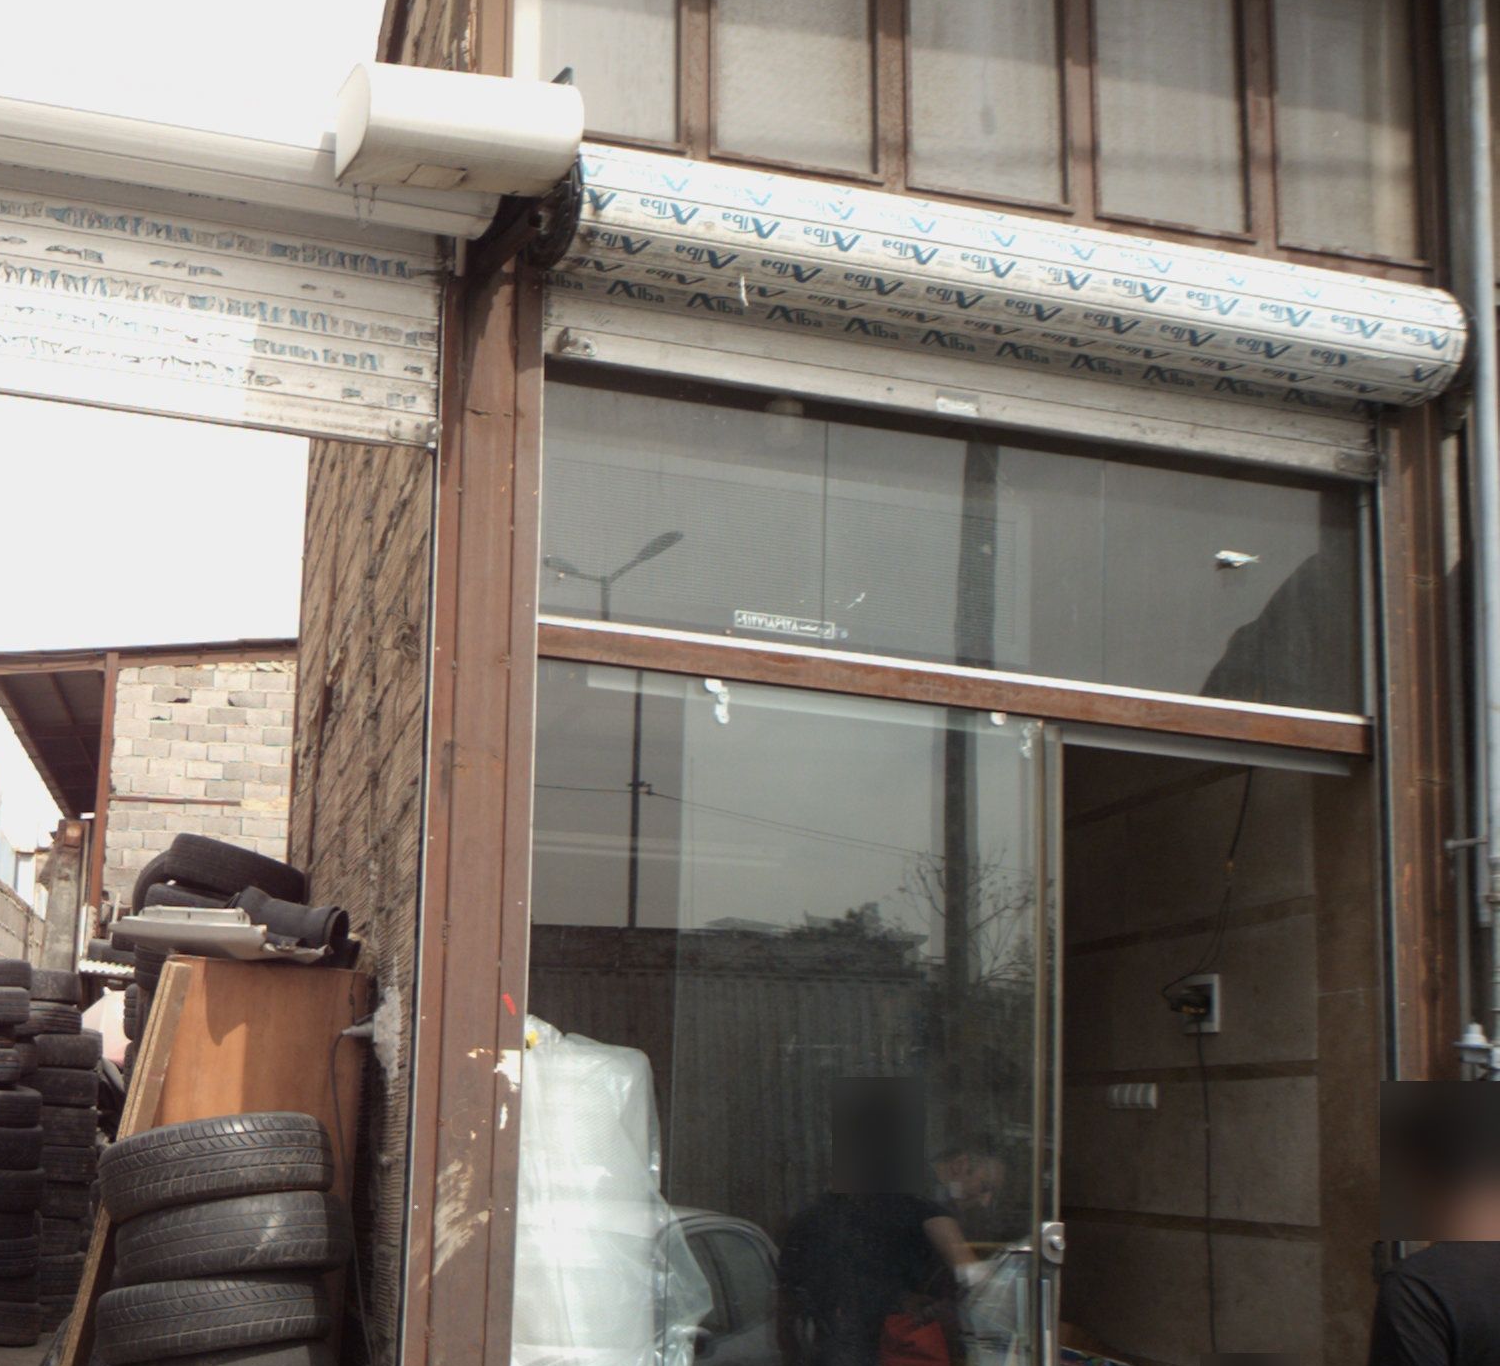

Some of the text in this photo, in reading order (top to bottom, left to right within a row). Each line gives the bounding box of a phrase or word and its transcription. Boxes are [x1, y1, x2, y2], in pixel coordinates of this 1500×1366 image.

[640, 197, 699, 225] Alba
[722, 212, 780, 239] Alba
[803, 226, 860, 252] Alba
[675, 244, 739, 270] Alba
[882, 239, 939, 265] Alba
[761, 258, 823, 284] Alba
[960, 252, 1017, 278] Alba
[844, 272, 904, 296] Alba
[1113, 278, 1167, 303] Alba
[926, 285, 985, 309] Alba
[1186, 290, 1239, 315] Alba
[1005, 298, 1063, 322] Alba
[1259, 302, 1312, 327] Alba
[1083, 311, 1141, 335] Alba
[1161, 324, 1218, 347] Alba
[1331, 315, 1383, 339] Alba
[1236, 336, 1293, 359] Alba
